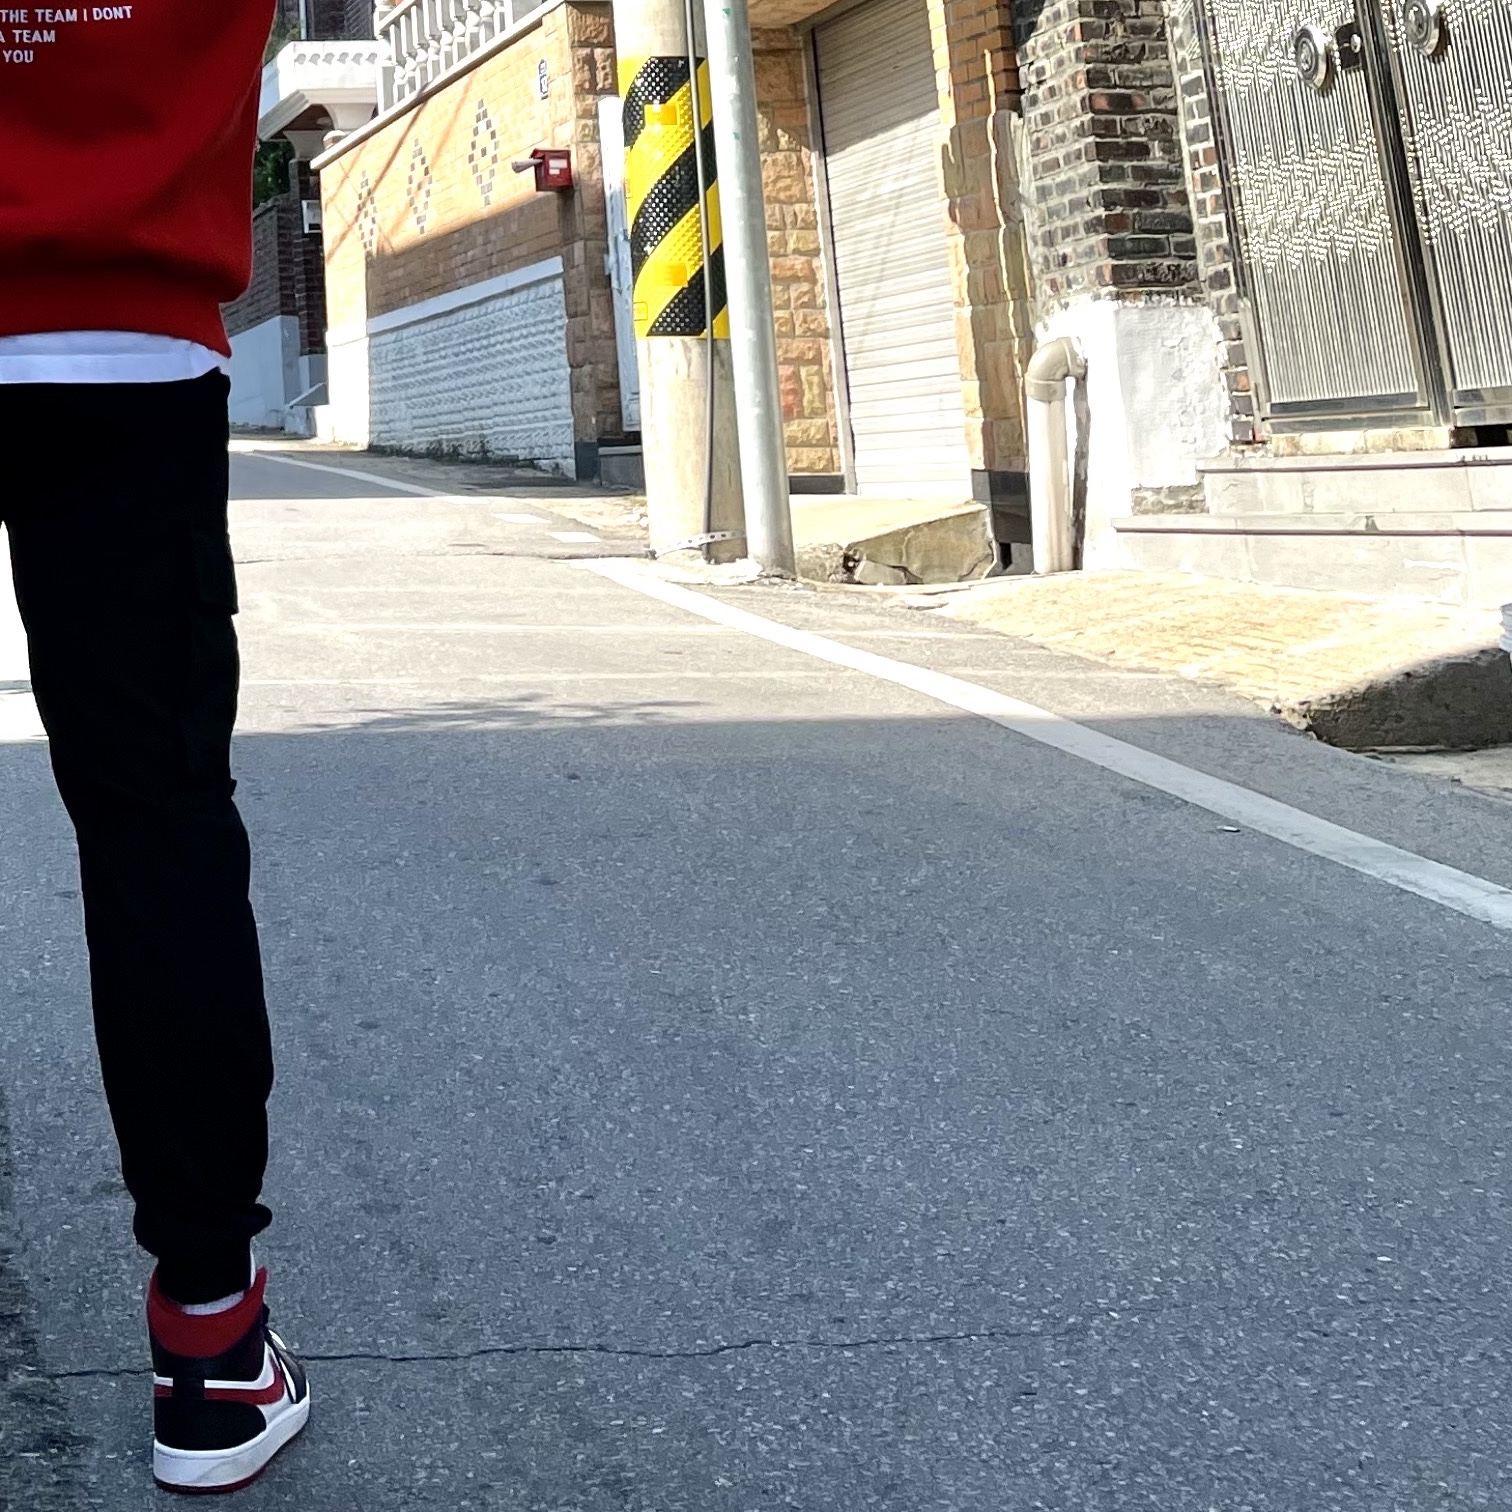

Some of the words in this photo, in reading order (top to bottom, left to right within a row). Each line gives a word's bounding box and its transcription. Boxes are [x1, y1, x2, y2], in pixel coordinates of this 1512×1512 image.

[0, 9, 28, 23] THE
[35, 9, 77, 23] TEAM
[83, 8, 88, 22] I
[92, 5, 132, 21] DONT
[12, 29, 55, 43] TEAM
[3, 49, 34, 63] YOU
